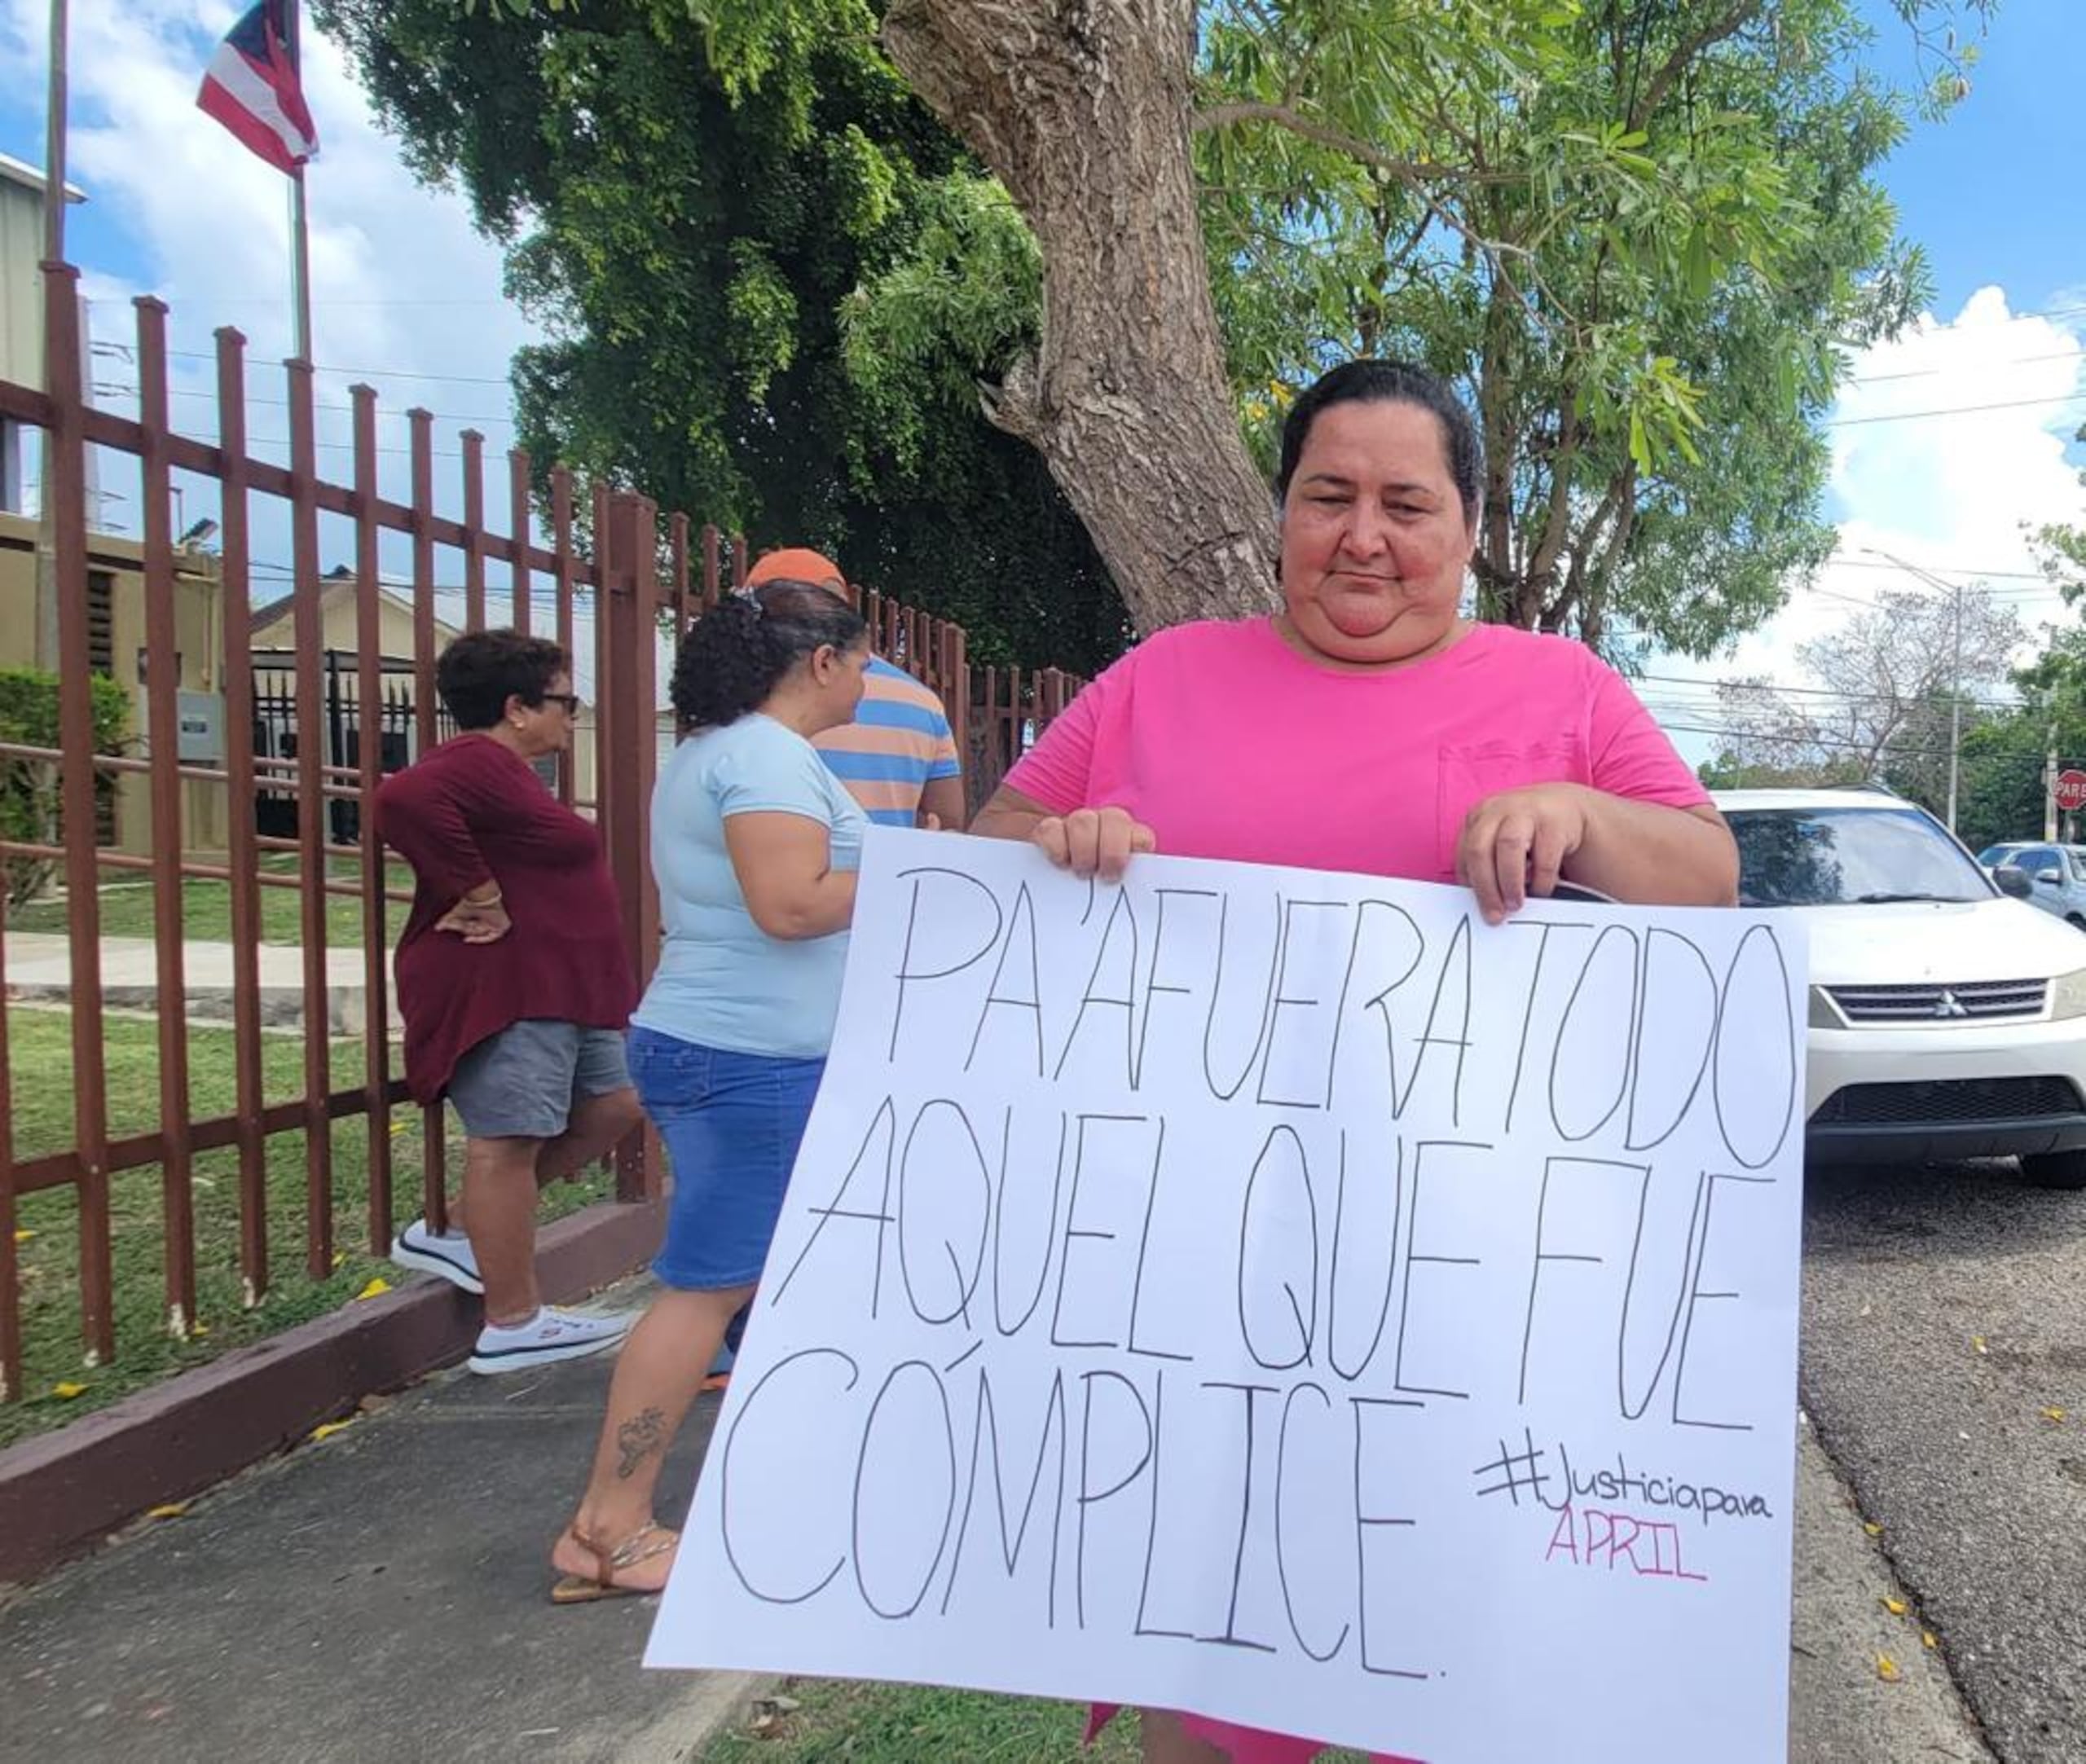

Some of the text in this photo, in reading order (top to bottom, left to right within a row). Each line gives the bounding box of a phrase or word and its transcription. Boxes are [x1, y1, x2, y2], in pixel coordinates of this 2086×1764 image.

[2053, 781, 2086, 798] PARE
[1506, 919, 1797, 1170] TODO
[770, 1093, 1778, 1431] AQUEL QUE FUE
[1544, 1504, 1708, 1582] APRIL
